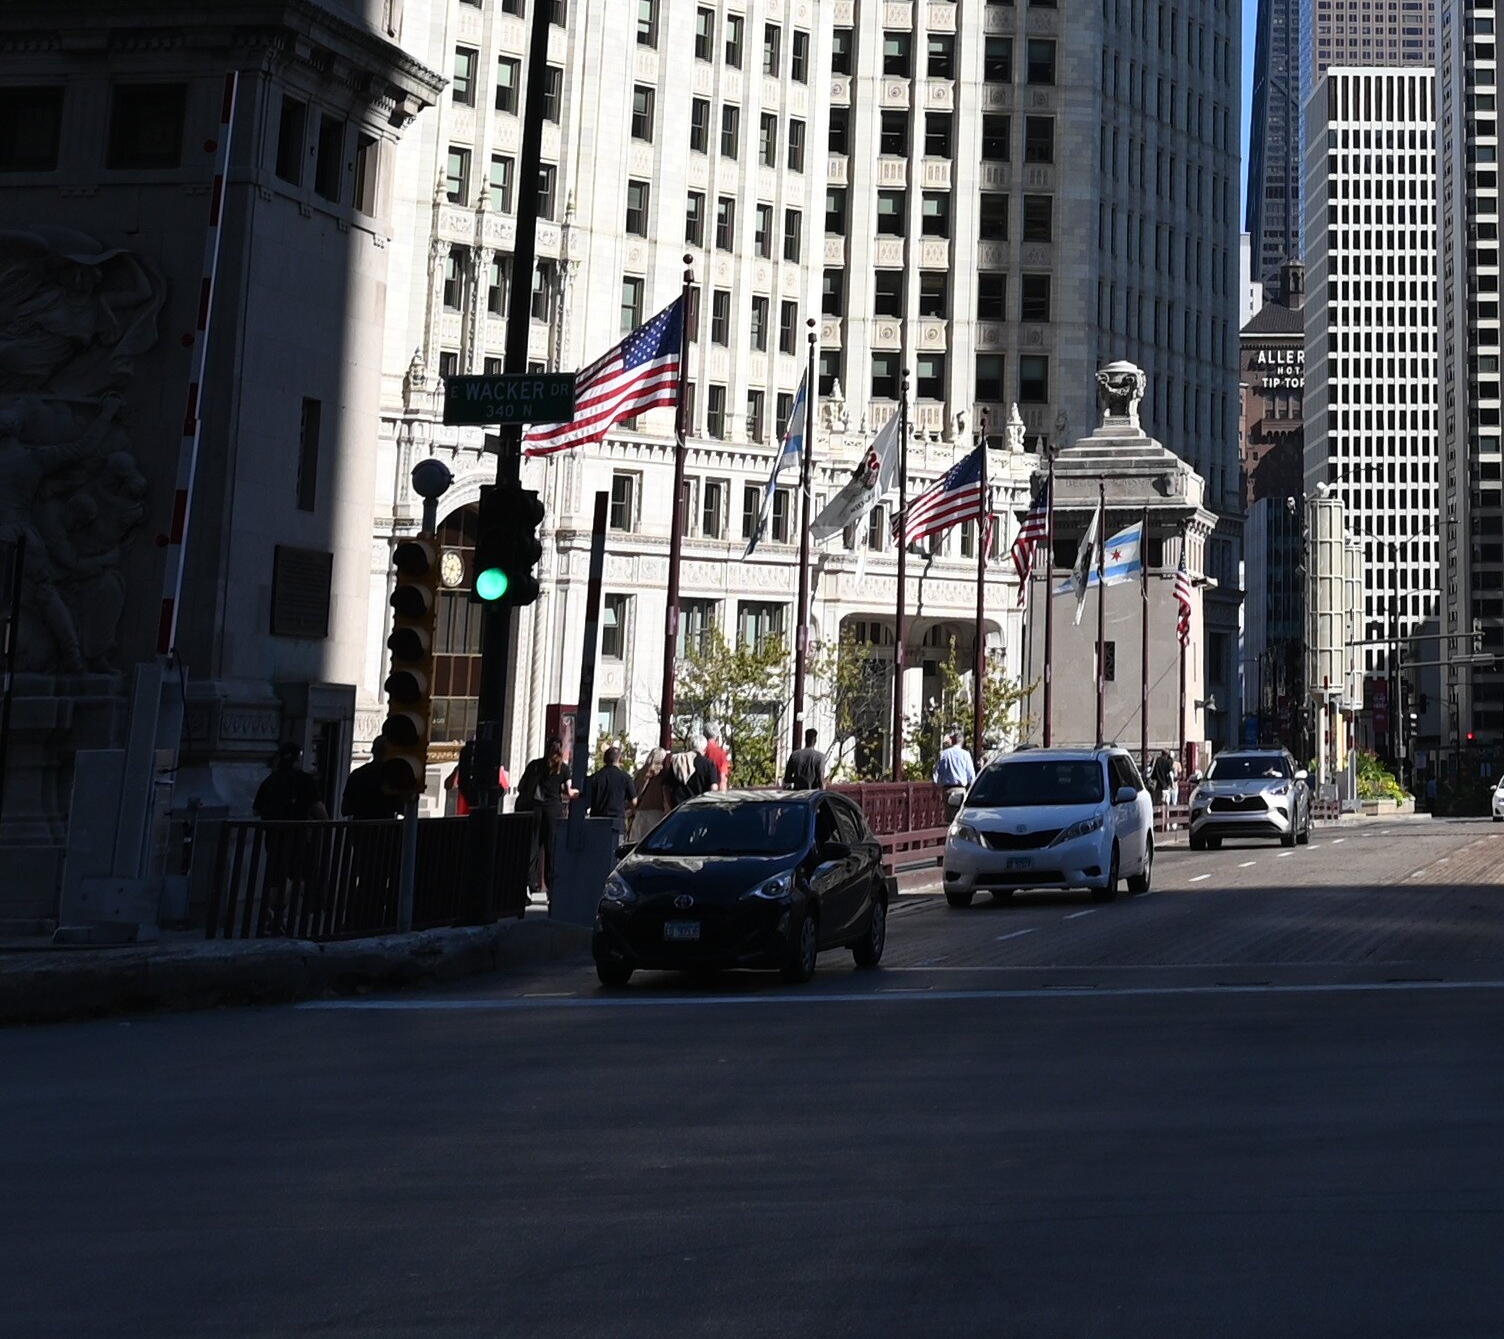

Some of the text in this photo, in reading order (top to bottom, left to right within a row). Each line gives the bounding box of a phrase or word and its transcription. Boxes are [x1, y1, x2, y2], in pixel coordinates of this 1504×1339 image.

[450, 382, 569, 401] E WACKER DR
[485, 404, 532, 418] 340 N
